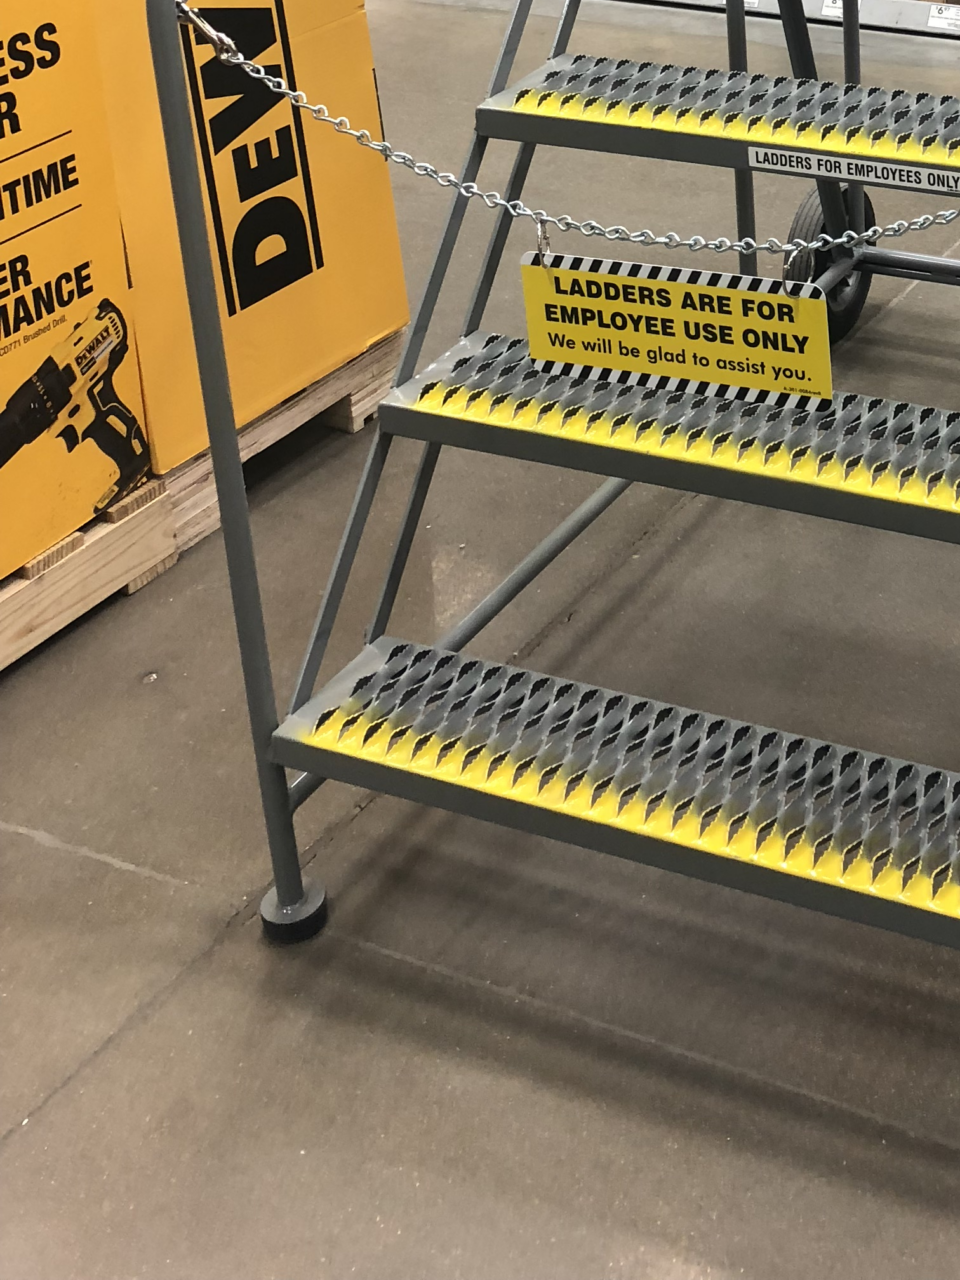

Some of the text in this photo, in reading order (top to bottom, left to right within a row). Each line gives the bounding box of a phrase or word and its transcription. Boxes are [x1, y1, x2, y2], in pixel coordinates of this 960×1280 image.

[755, 151, 960, 189] LADDERS FOR EMPLOYEES ONLY
[554, 276, 795, 323] LADDERS ARE FOR
[23, 323, 51, 344] Brushed
[52, 315, 67, 328] Drill.
[74, 325, 111, 367] DEWALT
[544, 304, 809, 354] EMPLOYEE USE ONLY
[548, 332, 812, 382] We will be glad to assist you.
